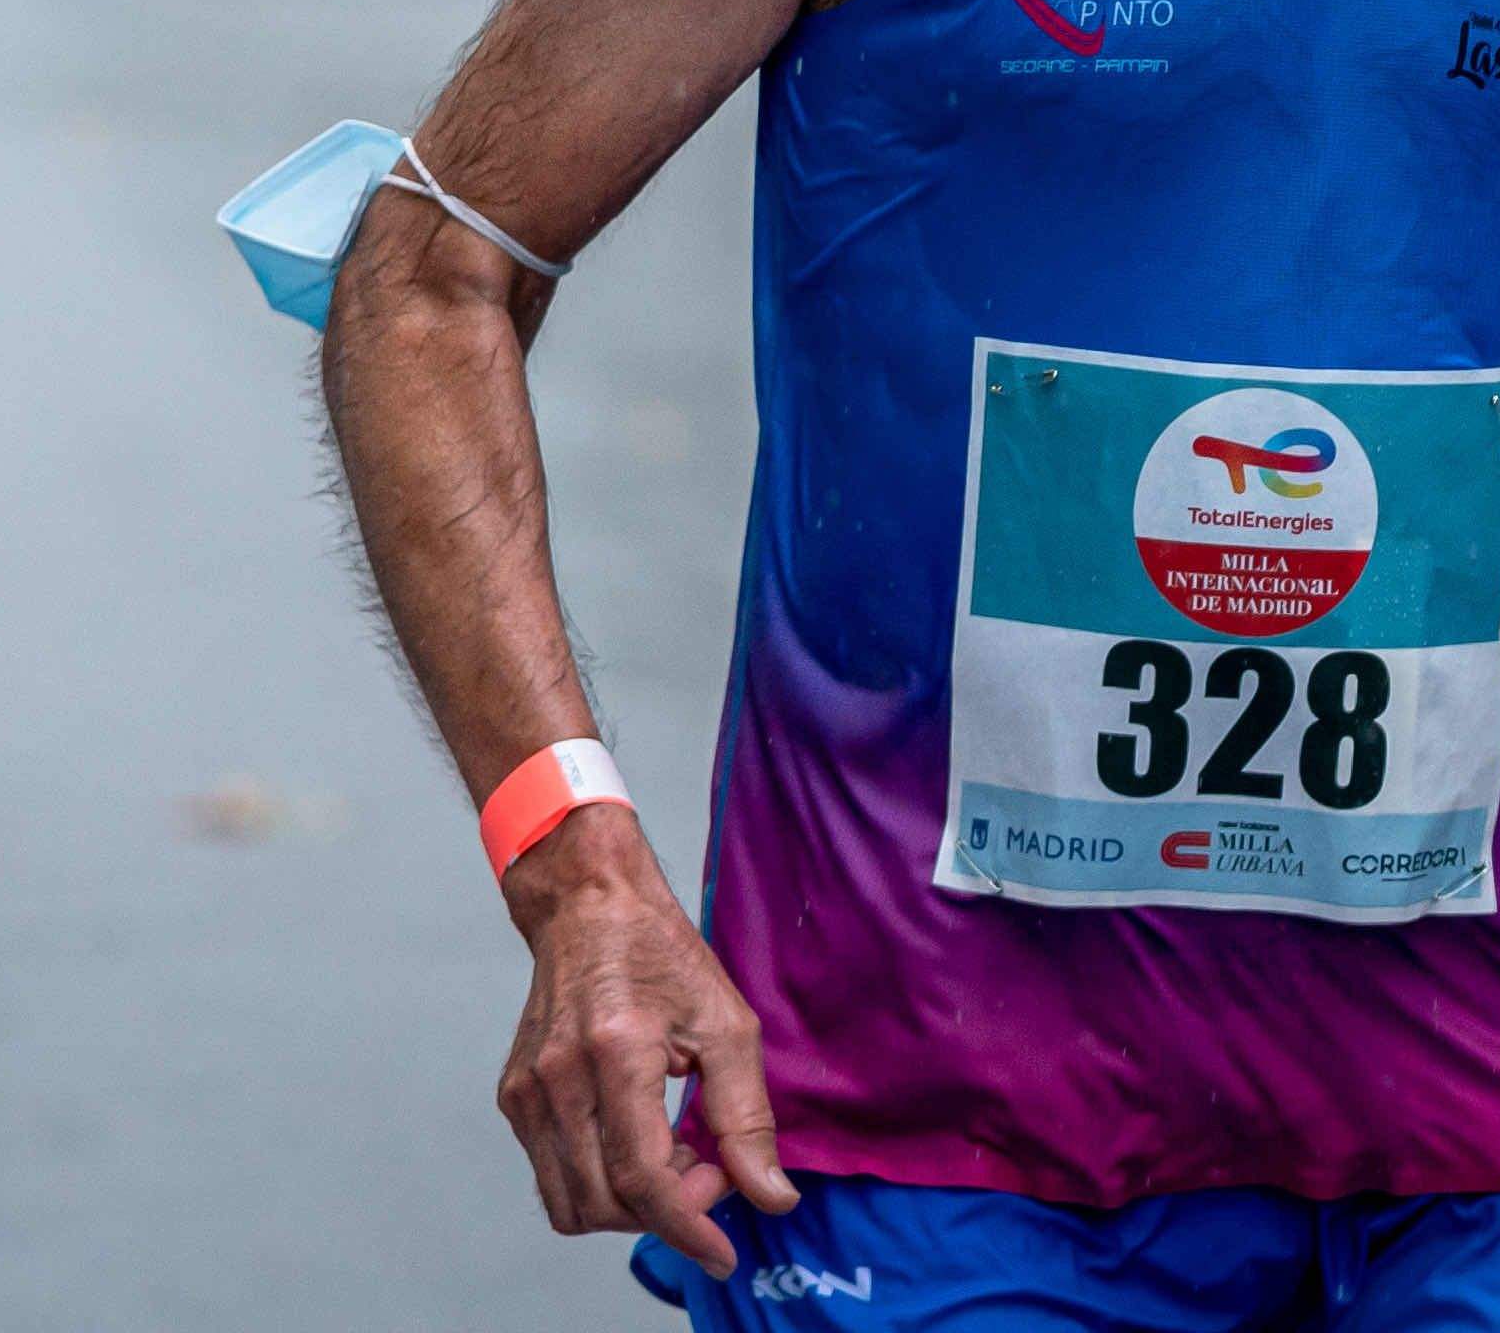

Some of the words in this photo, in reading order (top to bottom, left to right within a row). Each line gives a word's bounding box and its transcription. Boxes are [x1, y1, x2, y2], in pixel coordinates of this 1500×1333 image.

[1079, 0, 1174, 28] PNTO
[1187, 506, 1334, 535] TotalEnergies
[1220, 552, 1289, 573] MILLA
[1190, 594, 1222, 614] DE
[1226, 595, 1313, 618] MADRID
[1096, 639, 1391, 811] 328
[1005, 826, 1125, 863] MADRID
[1218, 832, 1295, 854] MILLA
[1216, 853, 1306, 877] URBANA
